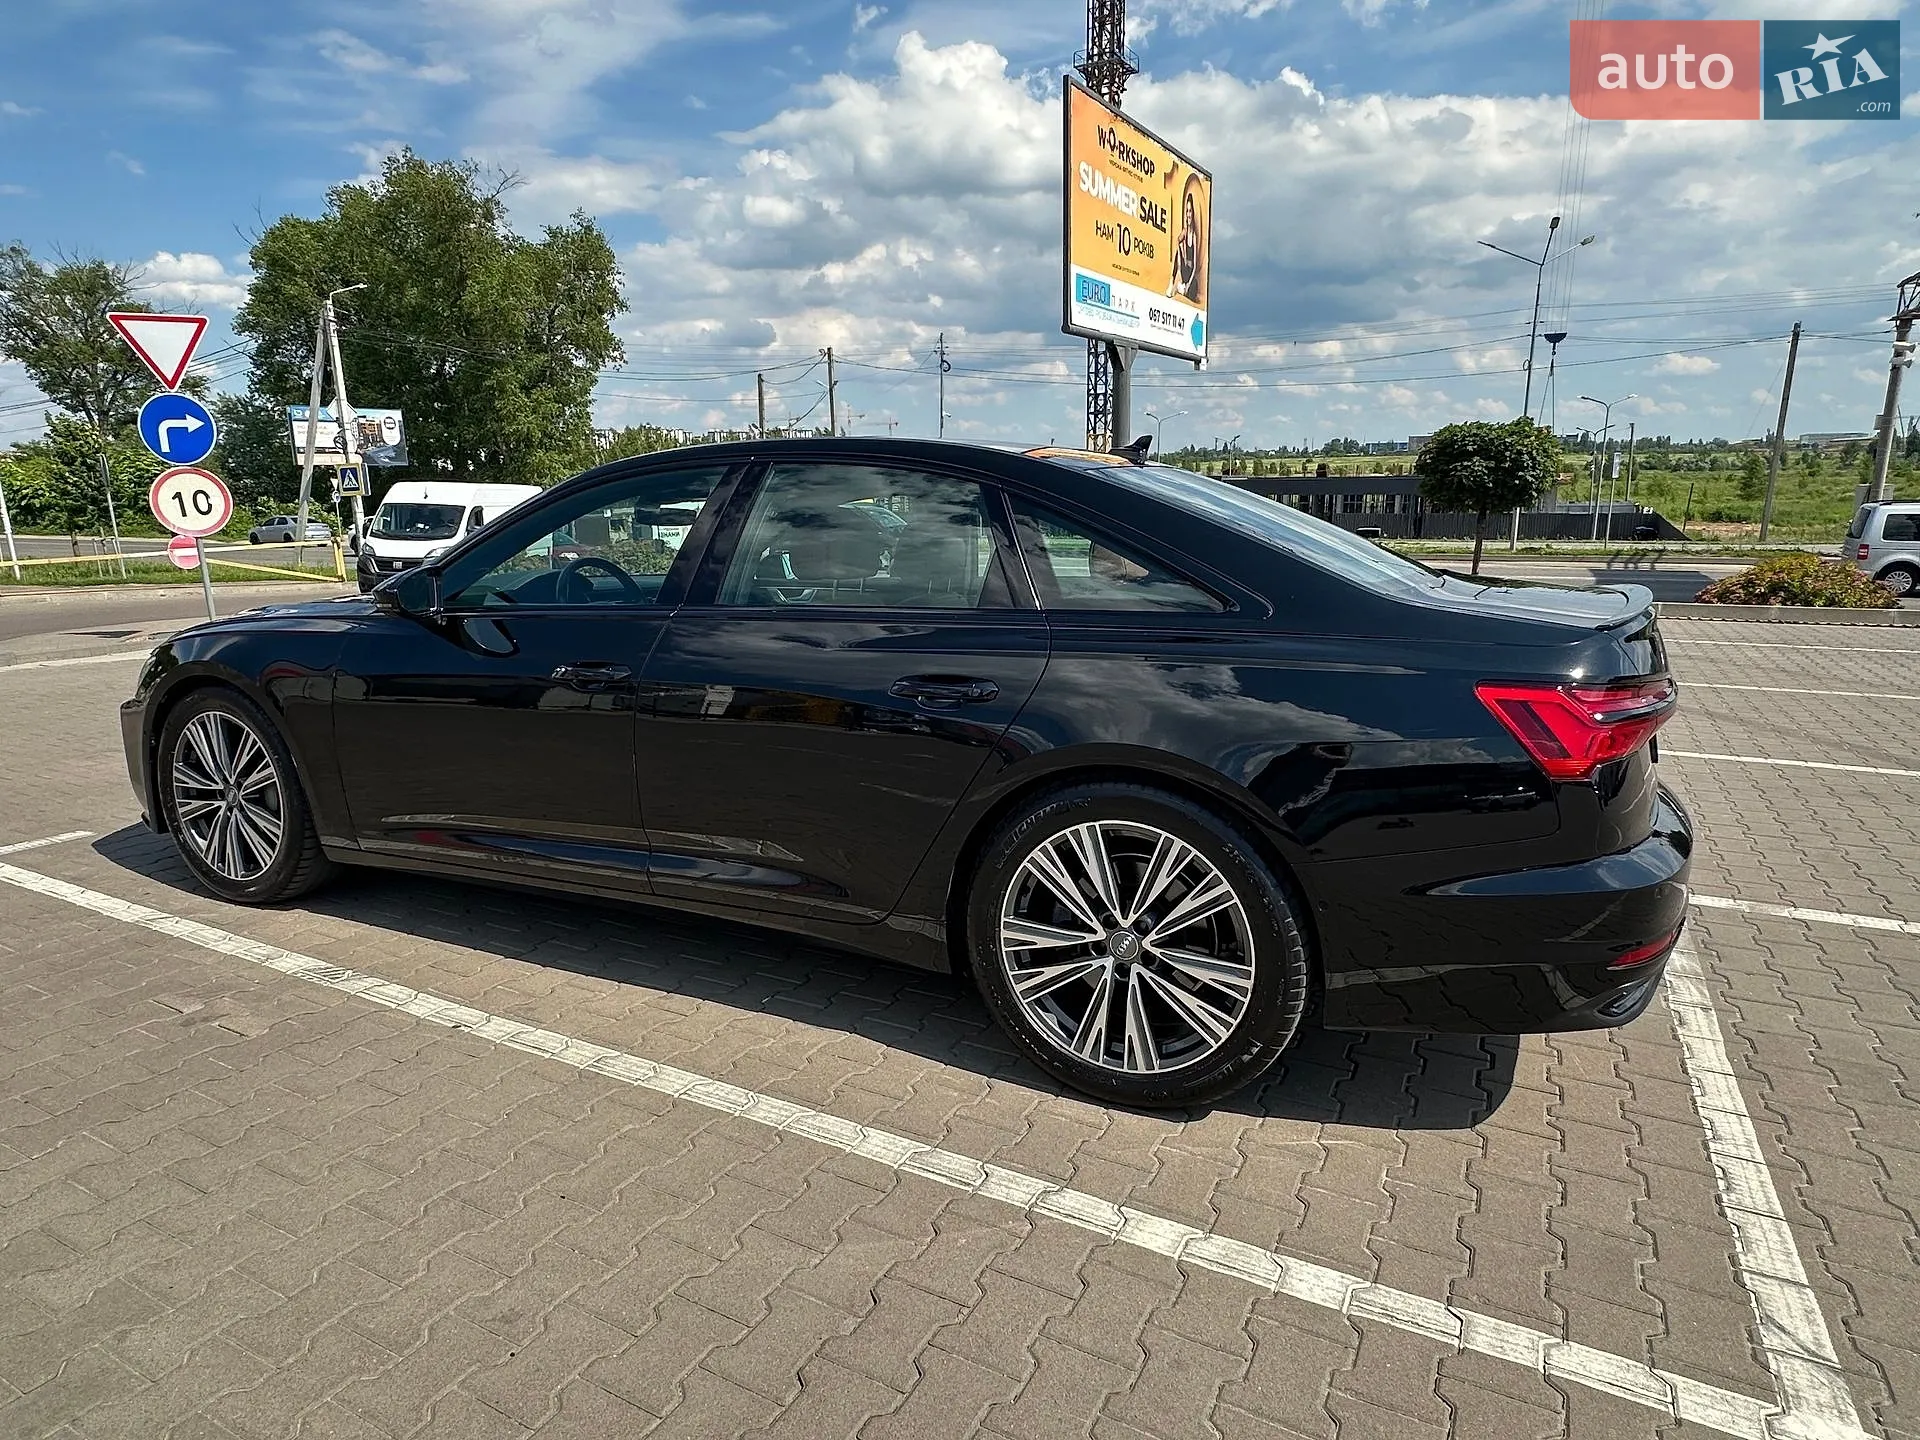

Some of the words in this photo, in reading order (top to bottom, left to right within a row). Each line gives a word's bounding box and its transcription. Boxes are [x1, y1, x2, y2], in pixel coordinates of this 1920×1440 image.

[1079, 160, 1138, 217] SUMMER
[1139, 195, 1167, 234] SALE
[1095, 220, 1114, 243] НАМ
[1117, 223, 1131, 256] 10
[1133, 237, 1155, 260] РОКІВ
[1081, 279, 1107, 304] EURO
[171, 489, 213, 518] 10
